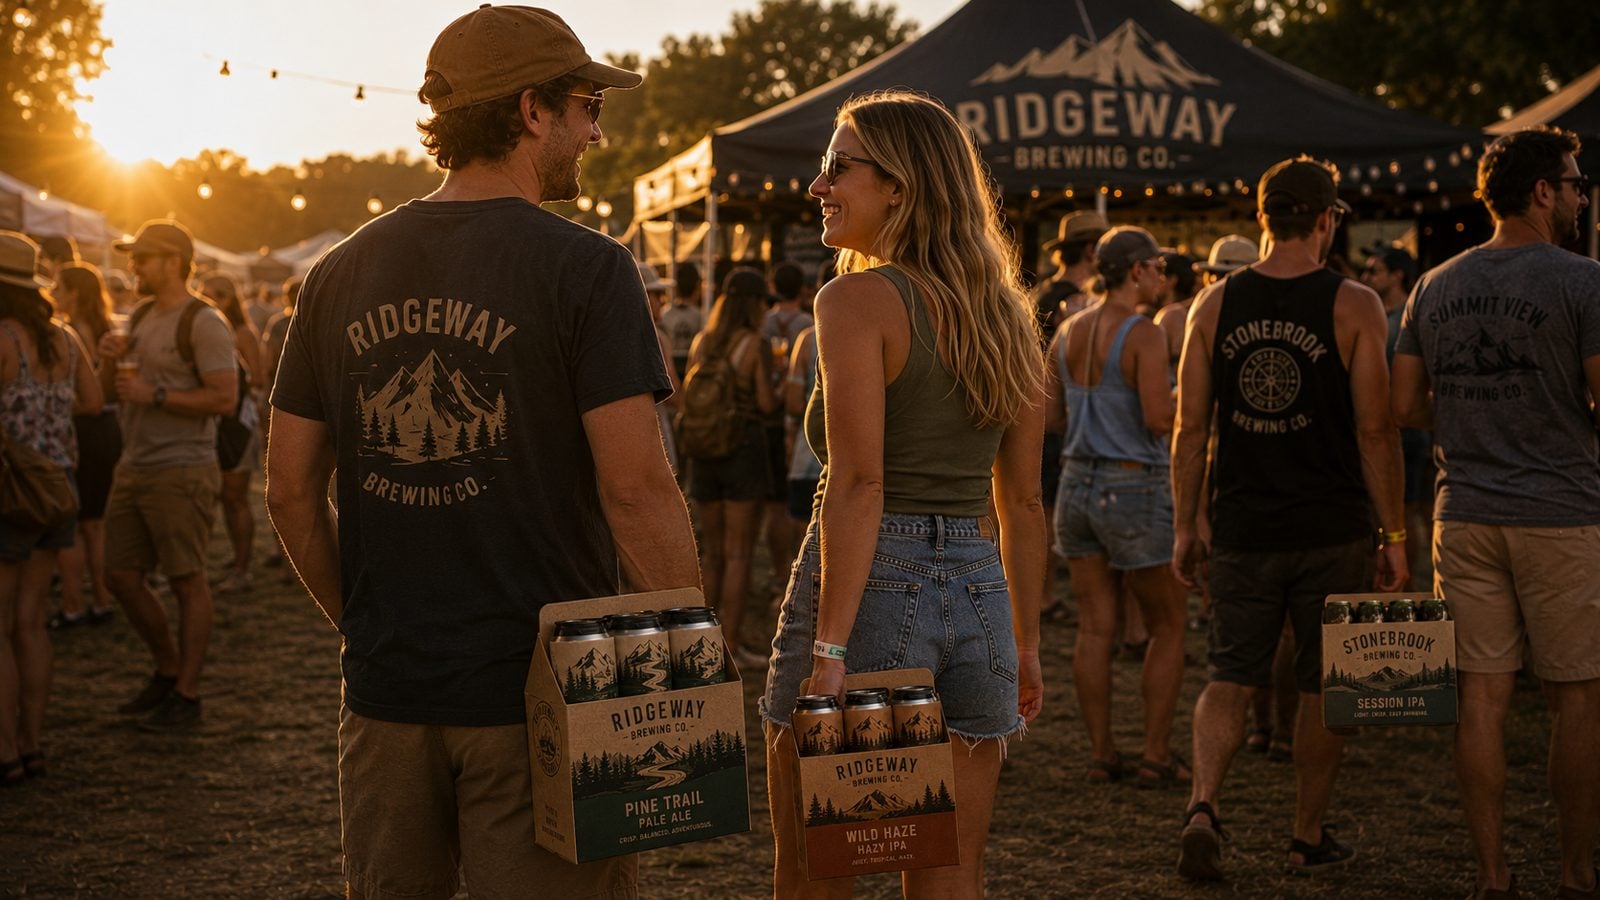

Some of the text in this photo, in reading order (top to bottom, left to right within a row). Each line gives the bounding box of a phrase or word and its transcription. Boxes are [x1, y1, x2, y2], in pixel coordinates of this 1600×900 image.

[956, 90, 1237, 147] RIDGEWAY
[1014, 146, 1176, 170] BREWING CO.
[1429, 296, 1549, 330] SUMMIT VIEW
[347, 298, 517, 356] RIDGEWAY
[1221, 319, 1327, 363] STONEBROOK
[1440, 382, 1526, 400] BREWING CO.
[1232, 410, 1312, 433] BREWING CO.
[363, 472, 487, 506] BREWING CO.
[1343, 631, 1436, 655] STONEBROOK
[1363, 651, 1416, 661] BREWING CO.
[1357, 697, 1425, 709] SESSION IPA
[611, 700, 705, 732] RIDGEWAY
[631, 722, 688, 740] BREWING CO.
[836, 757, 918, 780] RIDGEWAY
[852, 775, 903, 787] BREWING CO.
[625, 790, 704, 817] PINE TRAIL
[638, 810, 692, 828] PALE ALE
[619, 835, 638, 844] CRISP.
[846, 824, 917, 843] WILD HAZE
[857, 841, 907, 855] HAZY IPA
